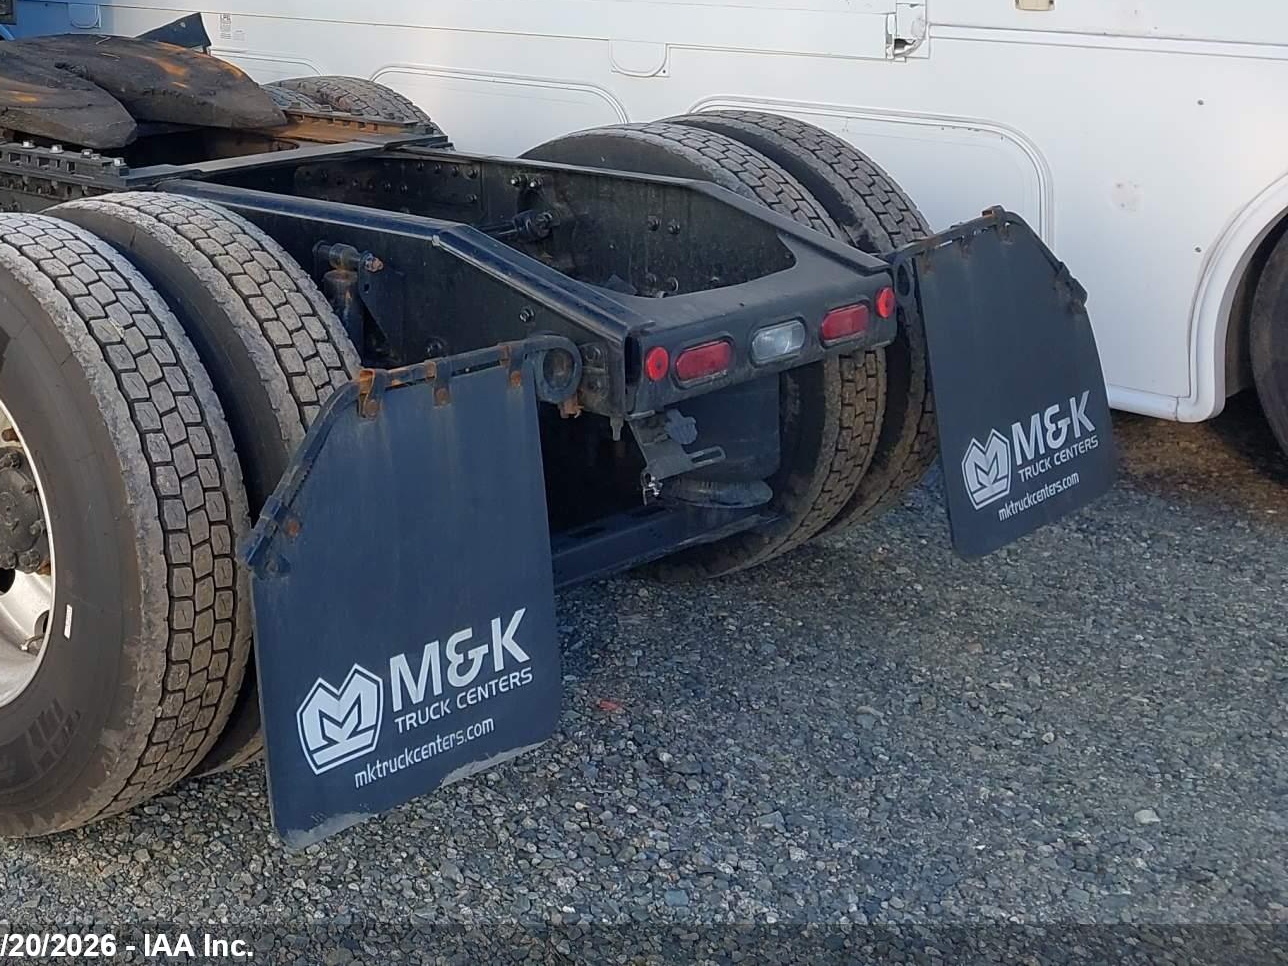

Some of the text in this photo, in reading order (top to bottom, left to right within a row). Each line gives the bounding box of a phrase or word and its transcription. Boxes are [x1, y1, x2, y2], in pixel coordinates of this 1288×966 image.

[1011, 389, 1096, 466] M&K
[1017, 435, 1099, 483] TRUCK CENTERS
[998, 471, 1080, 522] mktruckcenters.com
[389, 606, 531, 712] M&K
[394, 666, 534, 735] TRUCK CENTERS
[354, 715, 495, 789] mktruckcenters.com
